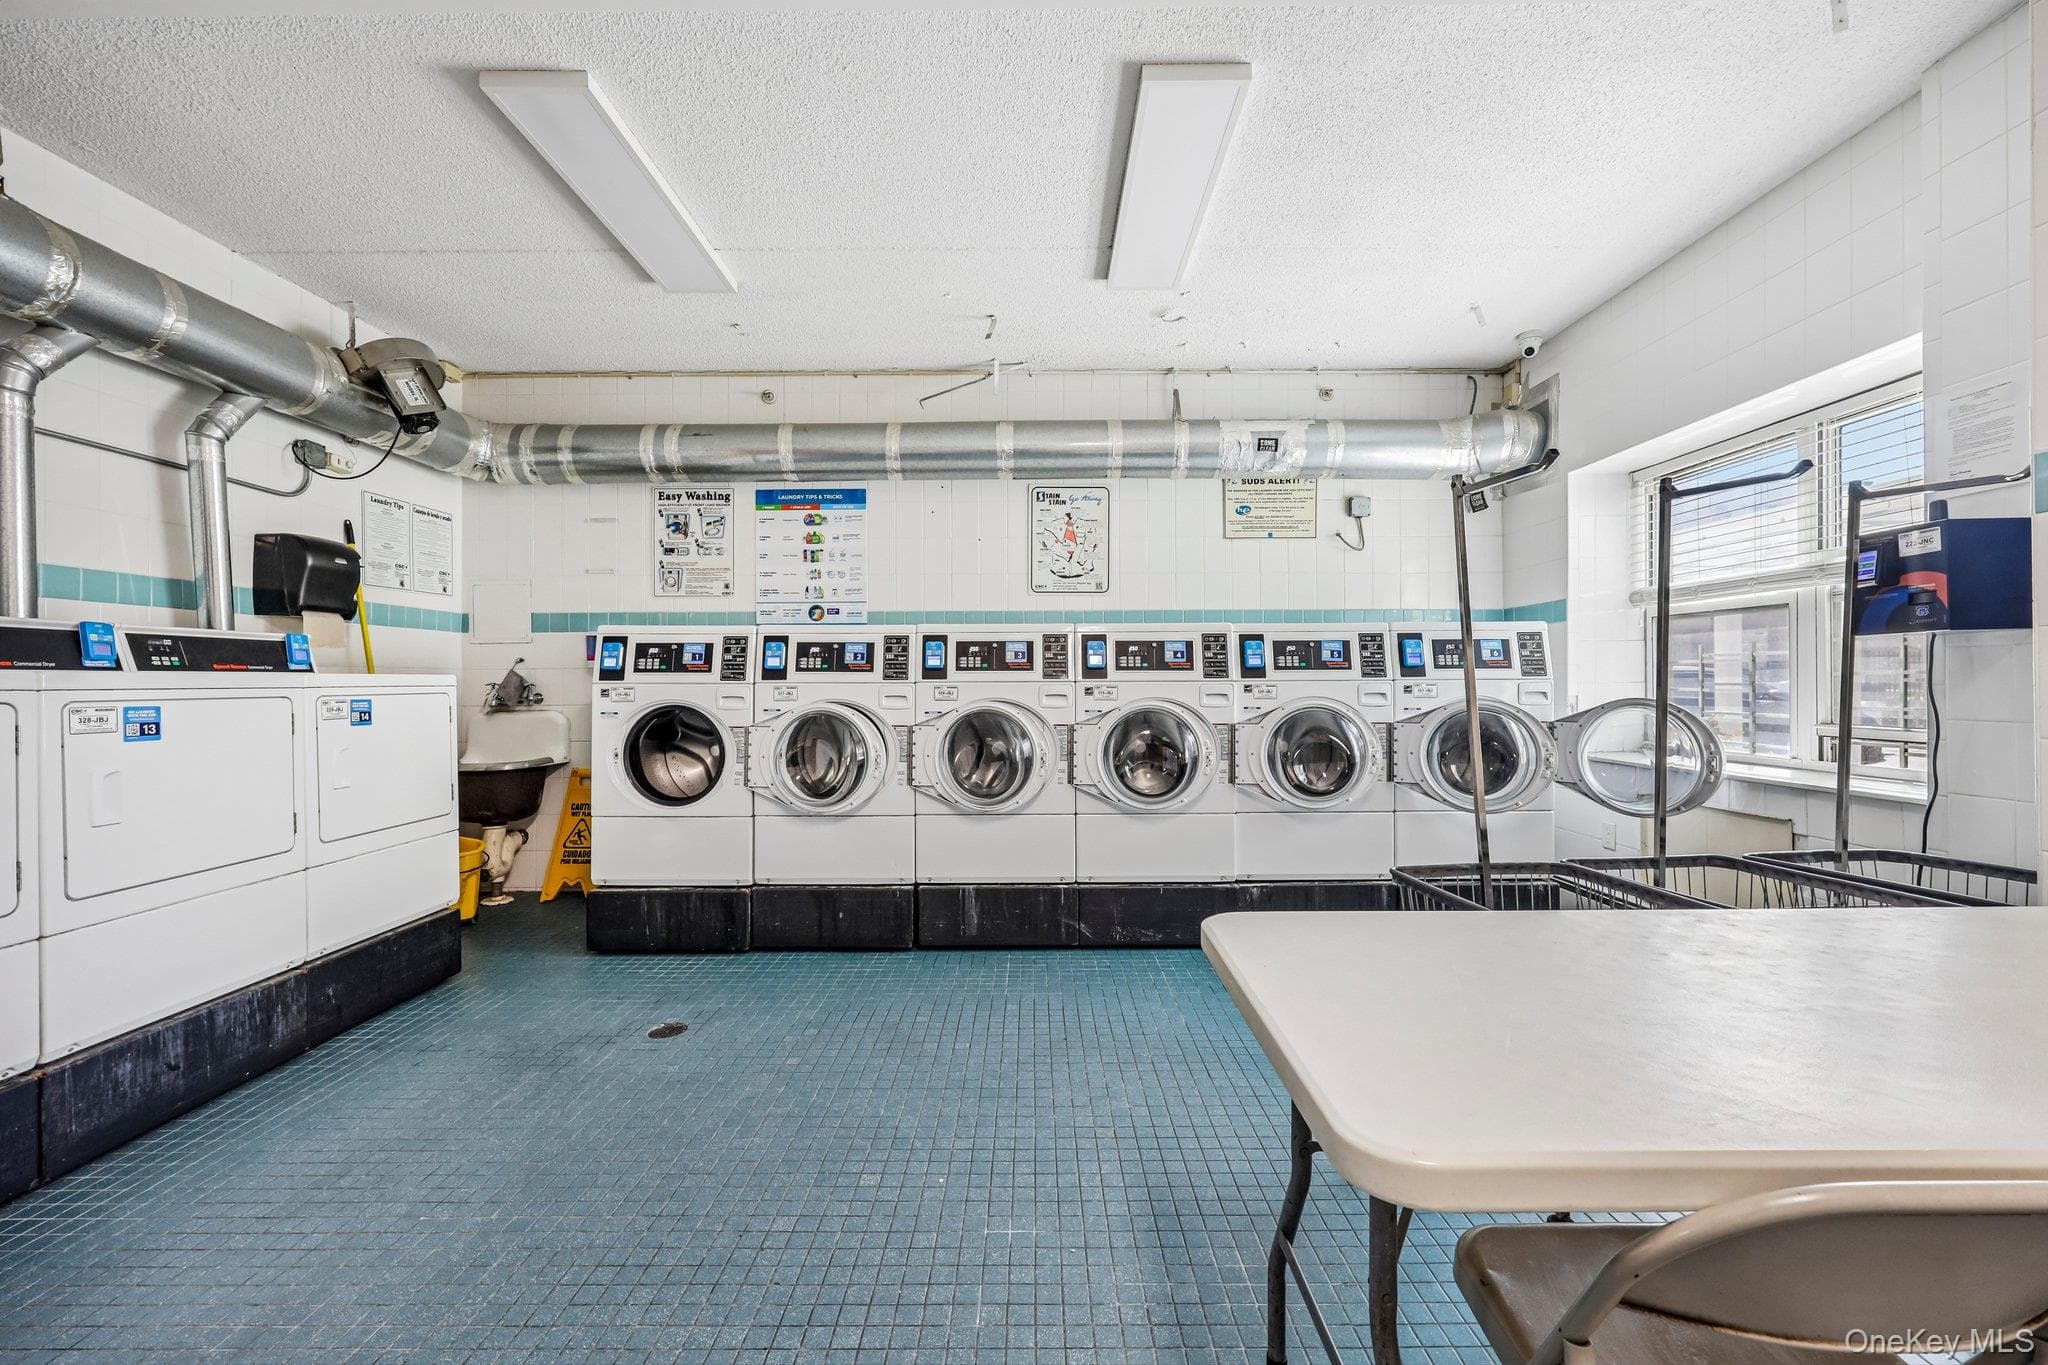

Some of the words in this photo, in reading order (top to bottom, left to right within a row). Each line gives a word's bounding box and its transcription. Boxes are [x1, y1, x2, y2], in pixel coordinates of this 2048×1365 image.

[370, 496, 392, 507] Laundry
[658, 491, 682, 503] Easy
[685, 491, 731, 503] Washing
[142, 724, 156, 734] 13
[571, 803, 591, 811] CAUTI
[563, 850, 591, 858] CUIDADO
